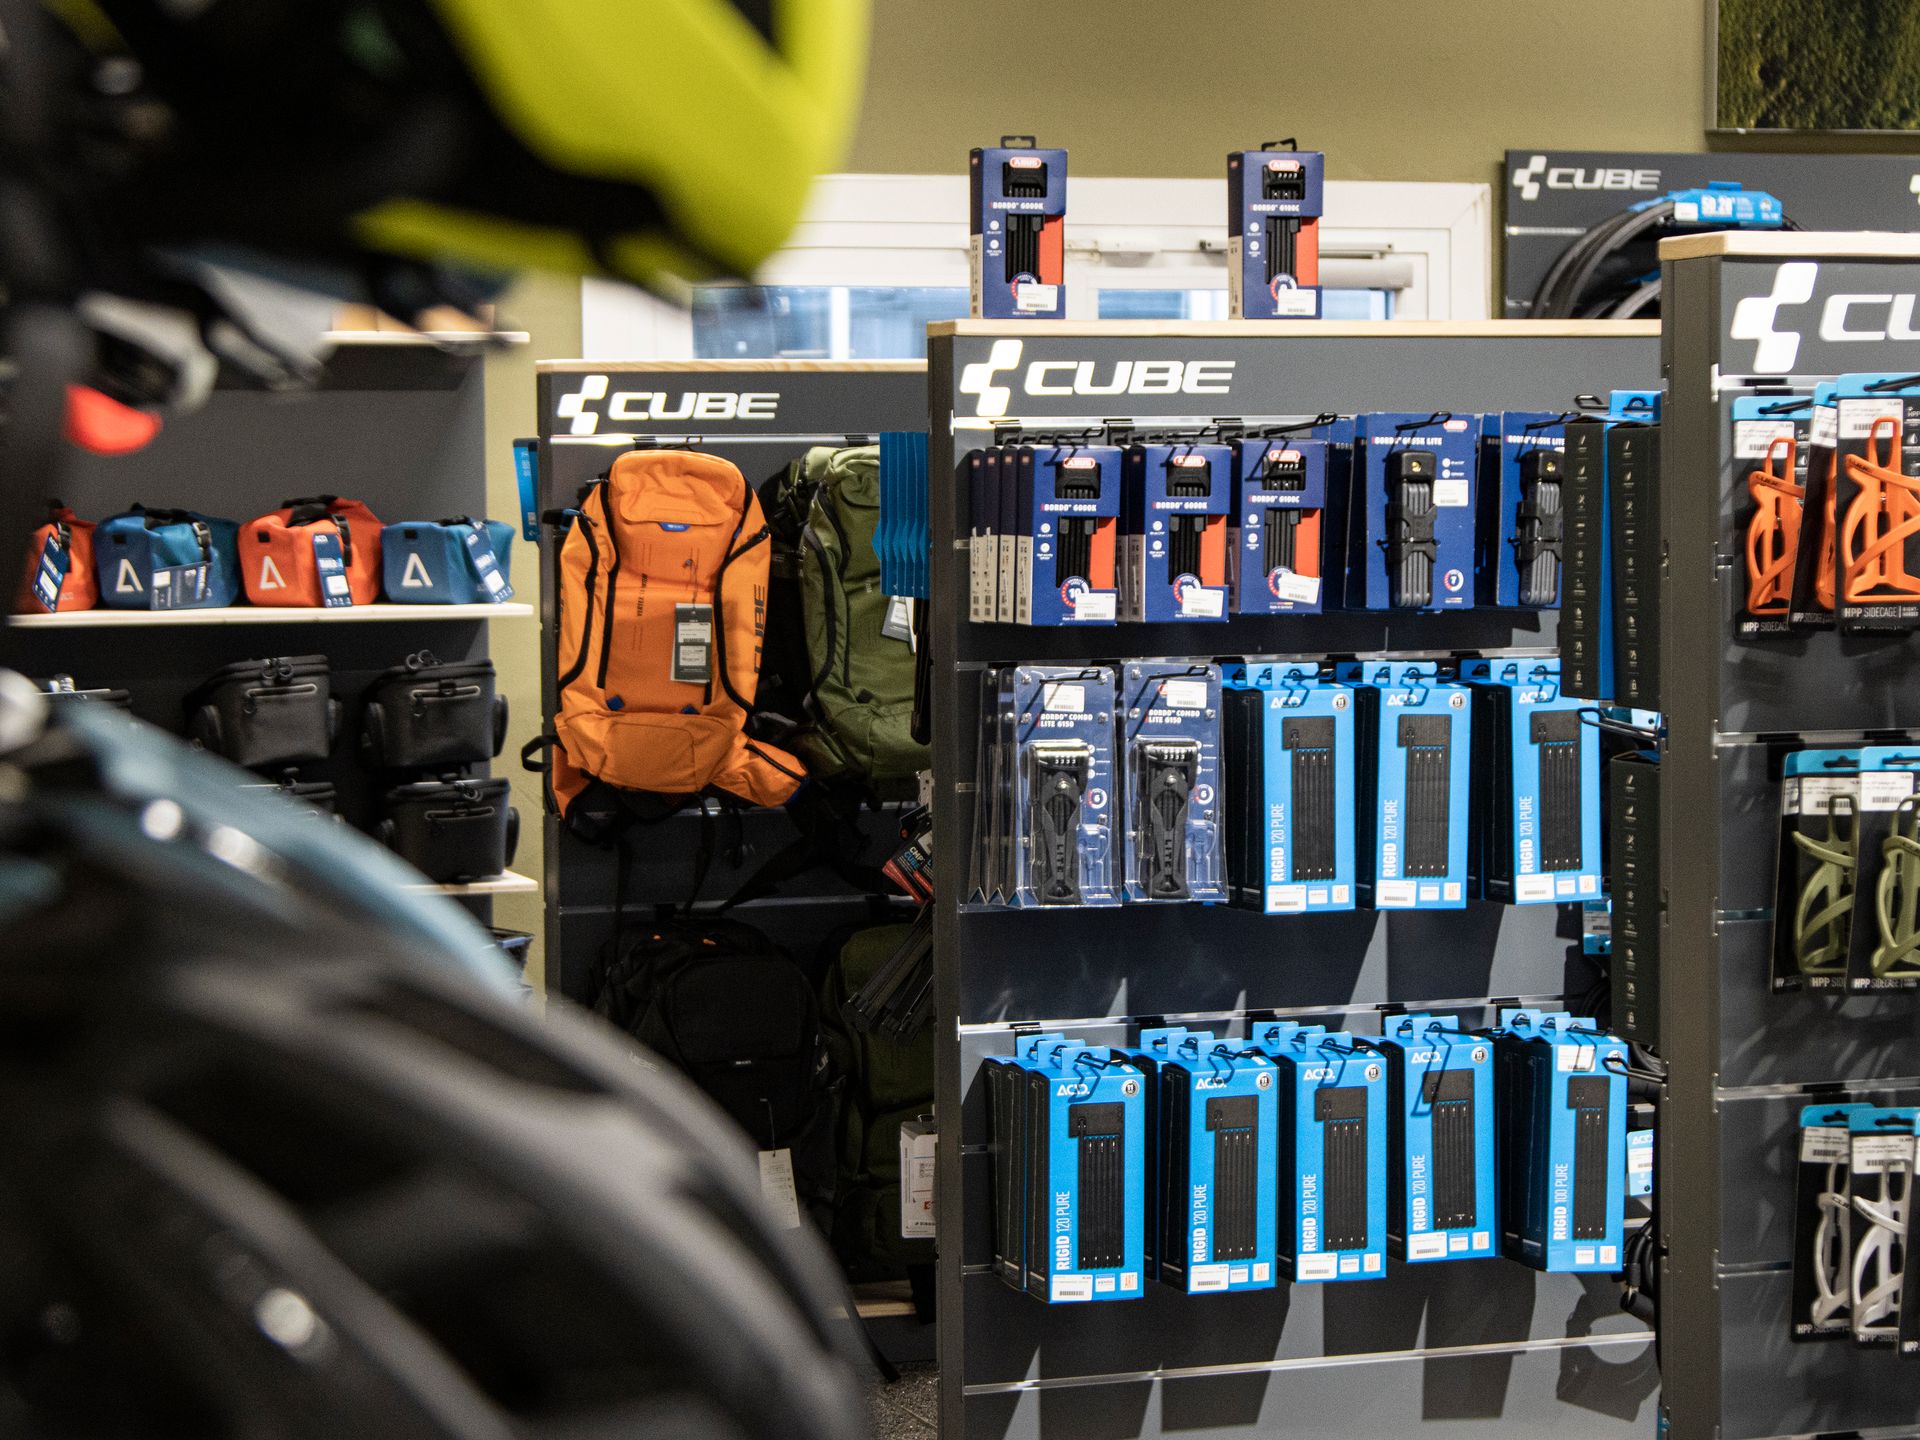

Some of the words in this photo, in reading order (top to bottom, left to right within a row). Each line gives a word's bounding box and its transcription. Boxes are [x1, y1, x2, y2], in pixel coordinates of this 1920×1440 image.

[1546, 168, 1662, 191] CUBE
[1024, 361, 1236, 395] CUBE
[608, 392, 780, 420] CUBE
[1845, 607, 1862, 618] HPP
[1864, 606, 1897, 618] SIDECAGE
[753, 583, 765, 674] CUBE
[1743, 621, 1760, 632] HPP
[1760, 621, 1789, 632] SIDECAG
[1057, 720, 1074, 728] 6150
[1271, 803, 1285, 827] PURE
[1383, 799, 1398, 824] PURE
[1520, 795, 1533, 820] PURE
[1271, 828, 1285, 845] 120
[1383, 825, 1398, 841] 120
[1520, 821, 1533, 836] 120
[1271, 847, 1285, 882] RIGID
[1382, 842, 1397, 878] RIGID
[1520, 838, 1534, 873] RIGID
[1811, 977, 1831, 988] HPP
[1854, 978, 1871, 989] HPP
[1412, 1154, 1426, 1178] PURE
[1555, 1163, 1569, 1187] PURE
[1194, 1184, 1207, 1208] PURE
[1303, 1173, 1317, 1198] PURE
[1412, 1180, 1426, 1195] 120
[1554, 1188, 1568, 1204] 100
[1056, 1190, 1070, 1216] PURE
[1303, 1199, 1316, 1215] 120
[1412, 1197, 1426, 1232] RIGID
[1056, 1217, 1070, 1233] 120
[1193, 1210, 1207, 1225] 120
[1553, 1206, 1567, 1240] RIGID
[1193, 1227, 1206, 1262] RIGID
[1302, 1217, 1316, 1252] RIGID
[1056, 1235, 1070, 1270] RIGID
